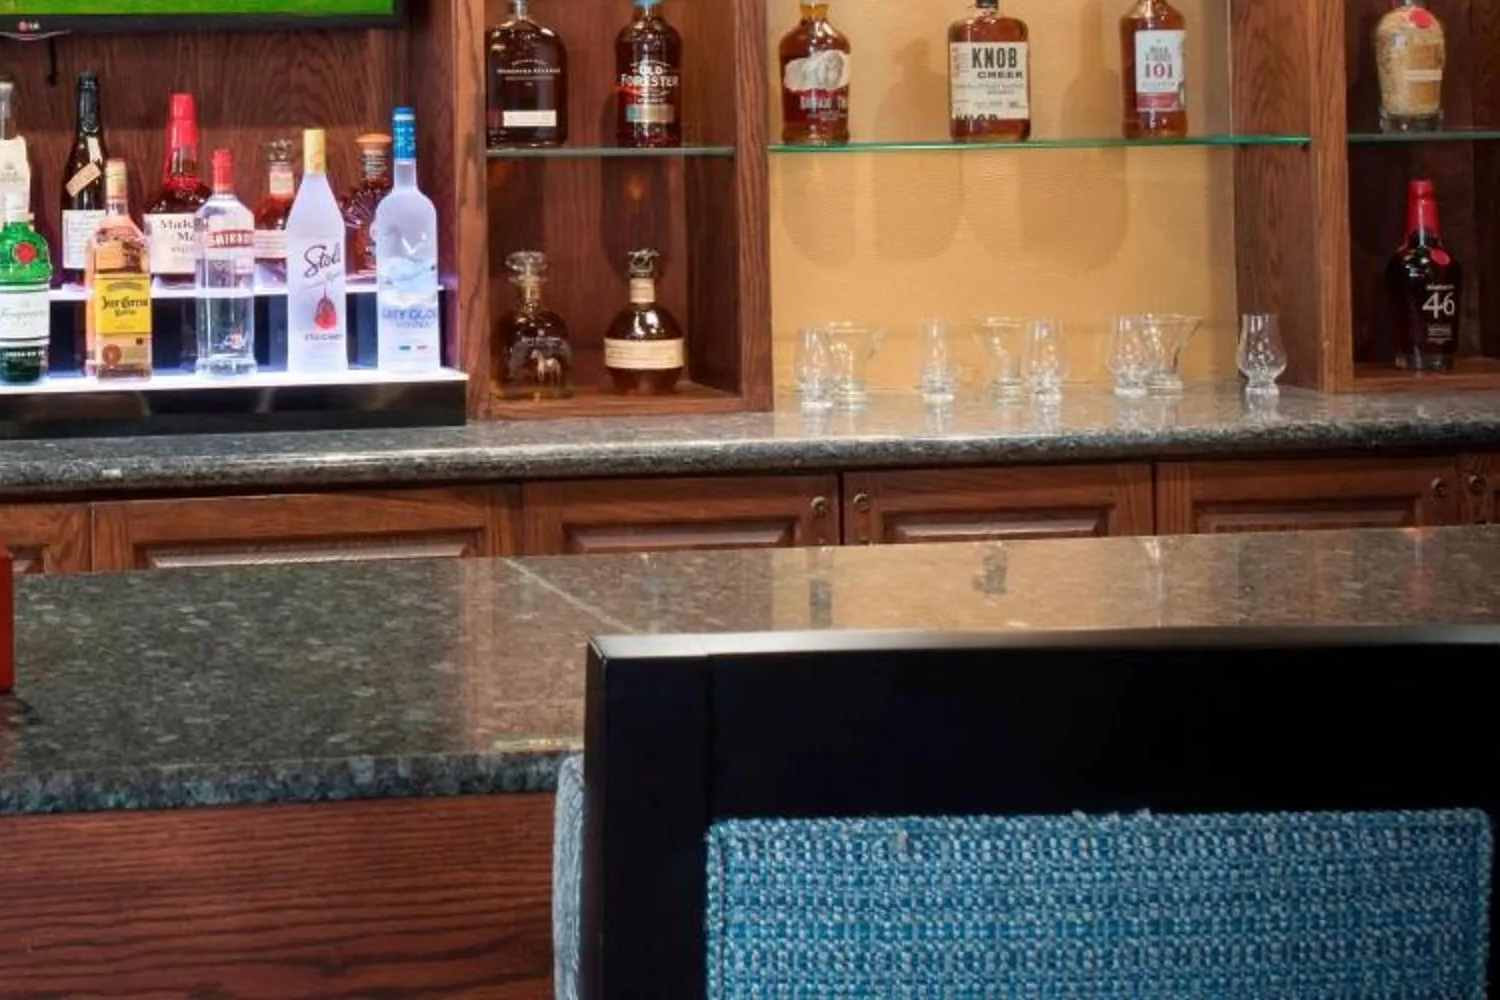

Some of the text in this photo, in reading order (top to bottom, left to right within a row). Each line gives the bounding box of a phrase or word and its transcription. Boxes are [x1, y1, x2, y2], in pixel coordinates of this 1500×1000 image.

[971, 47, 1017, 69] KNOB
[639, 65, 663, 75] OLD
[977, 71, 1024, 79] CREEK
[1145, 64, 1173, 78] 101
[621, 73, 679, 87] FORESTER
[1422, 292, 1456, 319] 46
